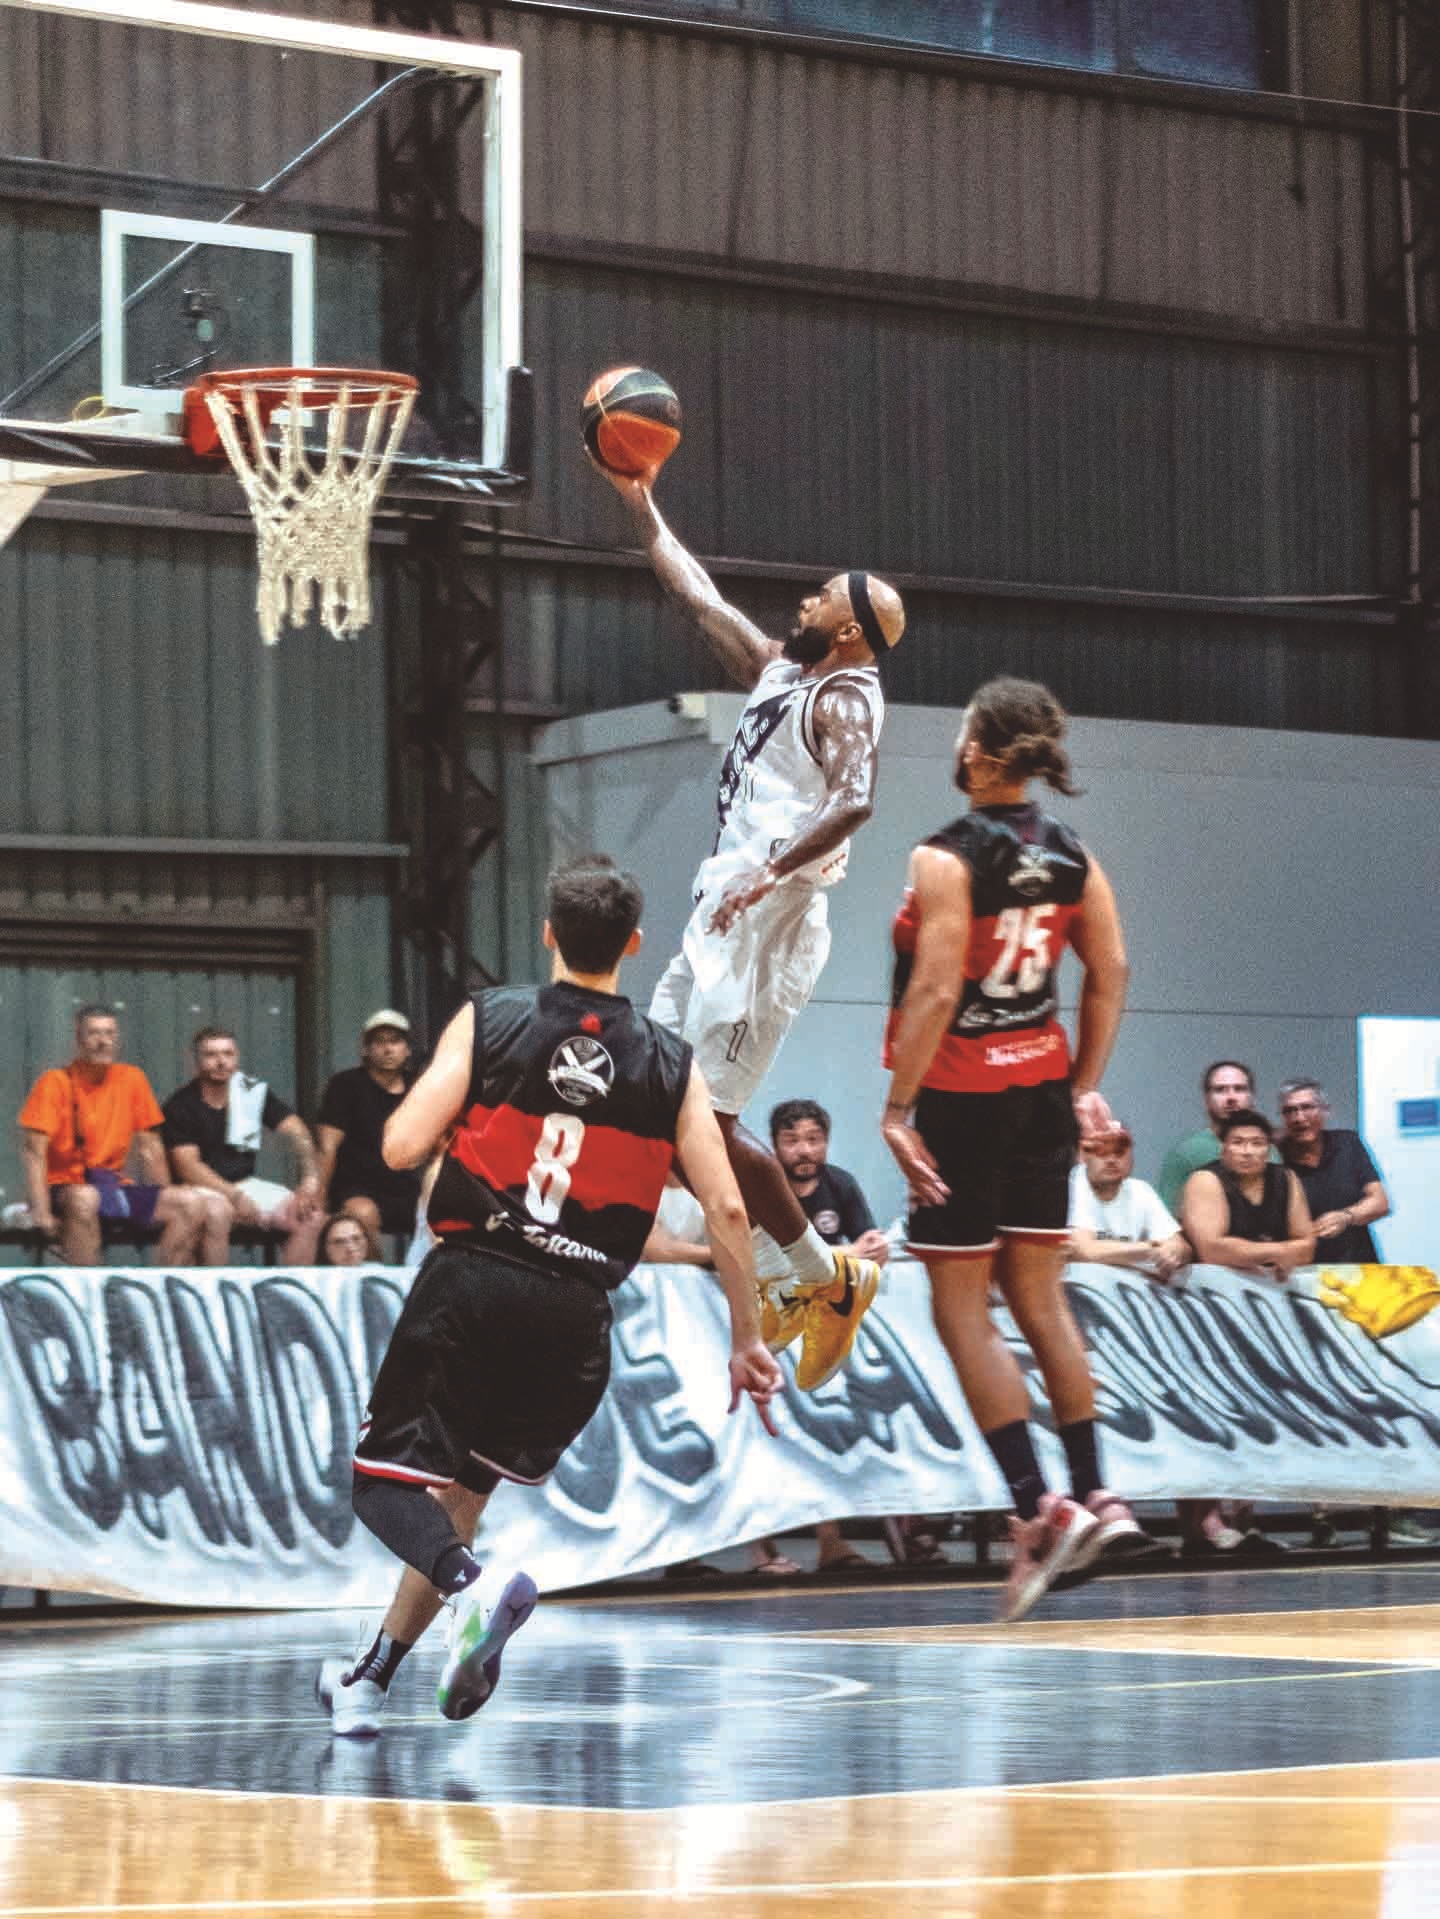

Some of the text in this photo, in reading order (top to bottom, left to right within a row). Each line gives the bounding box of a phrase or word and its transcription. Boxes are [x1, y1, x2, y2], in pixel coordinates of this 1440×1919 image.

[980, 903, 1056, 999] 25
[726, 1019, 748, 1063] 1
[524, 1112, 586, 1225] 8
